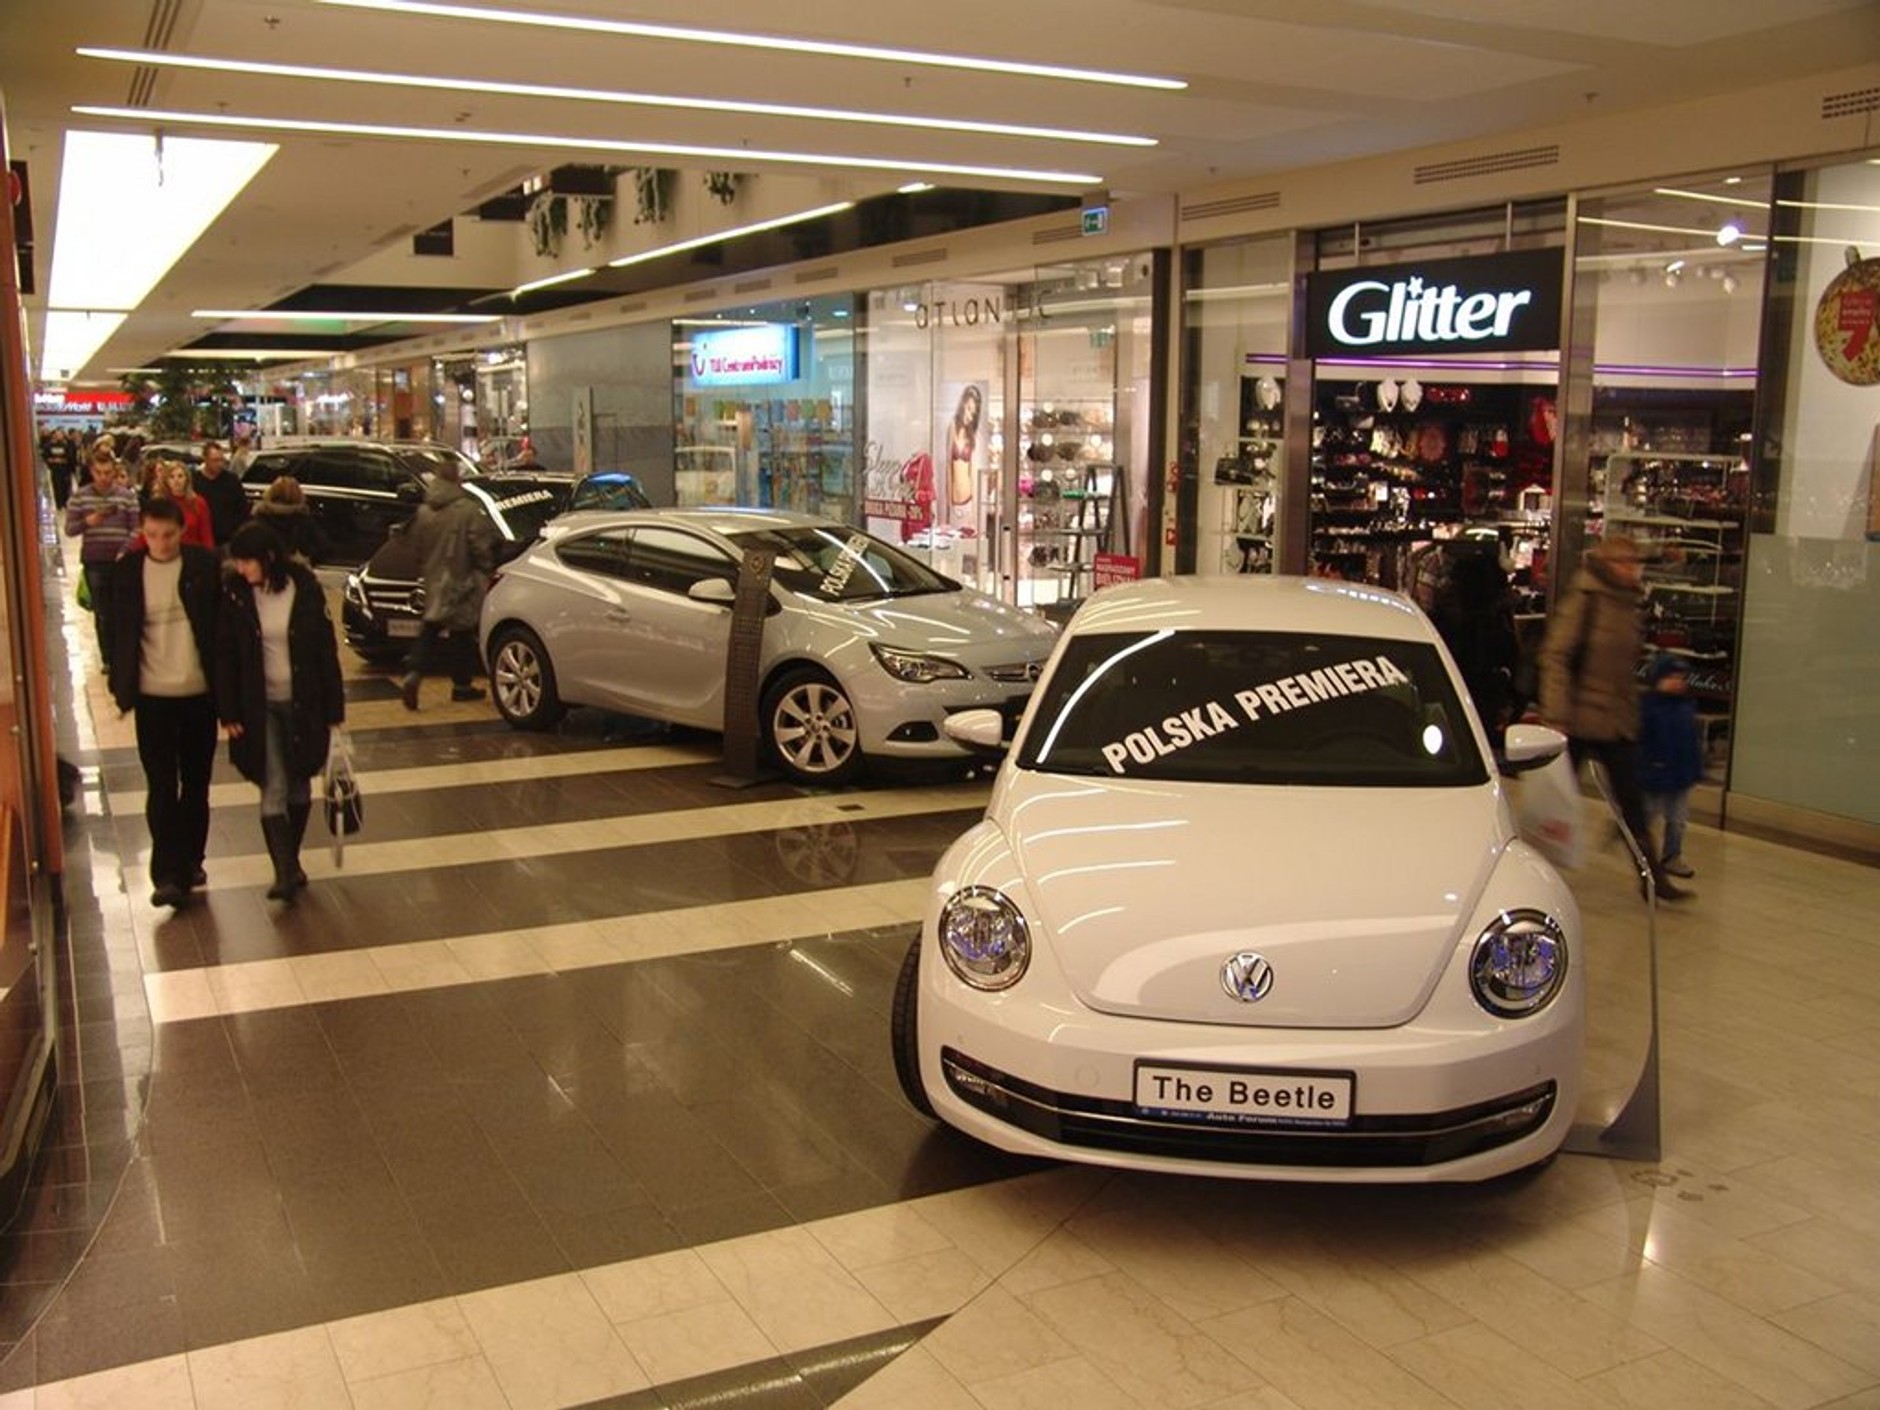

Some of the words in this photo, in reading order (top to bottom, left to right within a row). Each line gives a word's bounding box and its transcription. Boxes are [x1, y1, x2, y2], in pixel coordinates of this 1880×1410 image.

[1328, 276, 1532, 345] Glitter
[1101, 701, 1239, 774] POLSKA
[1234, 656, 1408, 721] PREMIERA
[1152, 1075, 1214, 1102] The
[1229, 1081, 1336, 1110] Beetle
